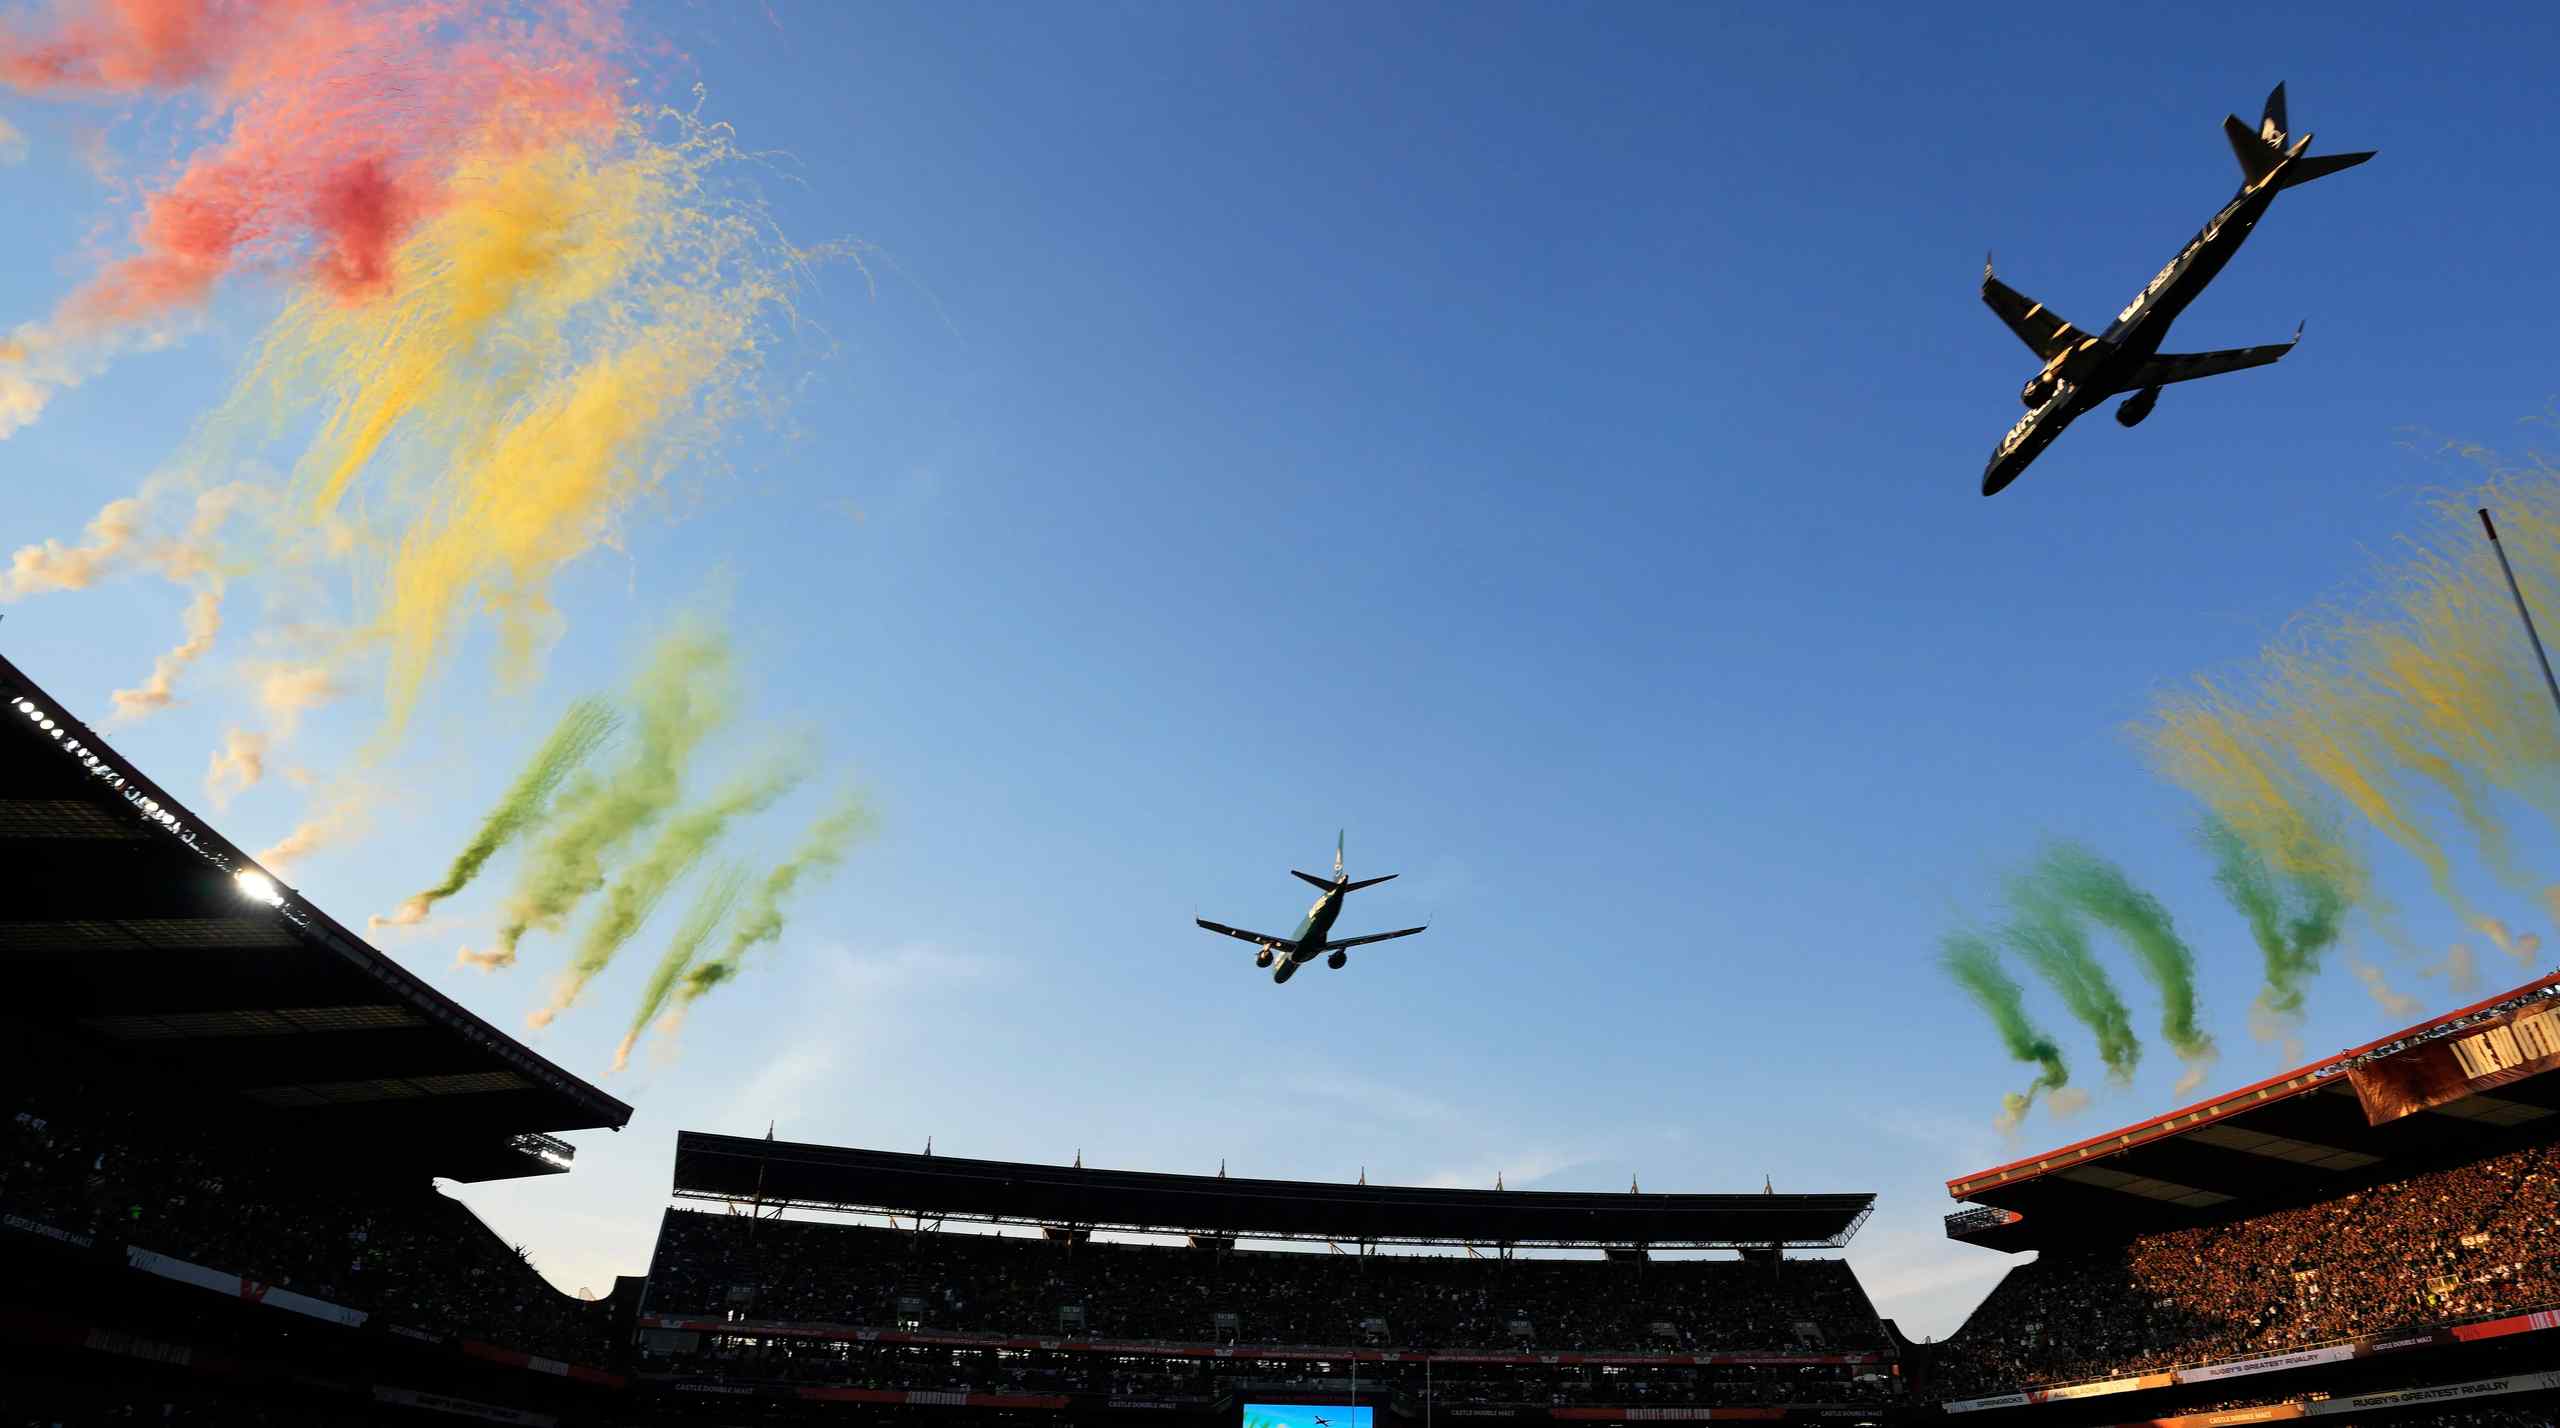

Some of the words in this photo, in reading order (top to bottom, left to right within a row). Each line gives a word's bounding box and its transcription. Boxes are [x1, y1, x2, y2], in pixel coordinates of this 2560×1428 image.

[2449, 1032, 2502, 1080] LIKE
[2485, 1025, 2524, 1069] NO
[2244, 1359, 2284, 1372] GREATEST
[2286, 1354, 2319, 1365] RIVALRY
[2352, 1396, 2400, 1408] RUGBY'S
[2401, 1388, 2459, 1402] GREATEST
[2462, 1381, 2510, 1395] RIVALRY
